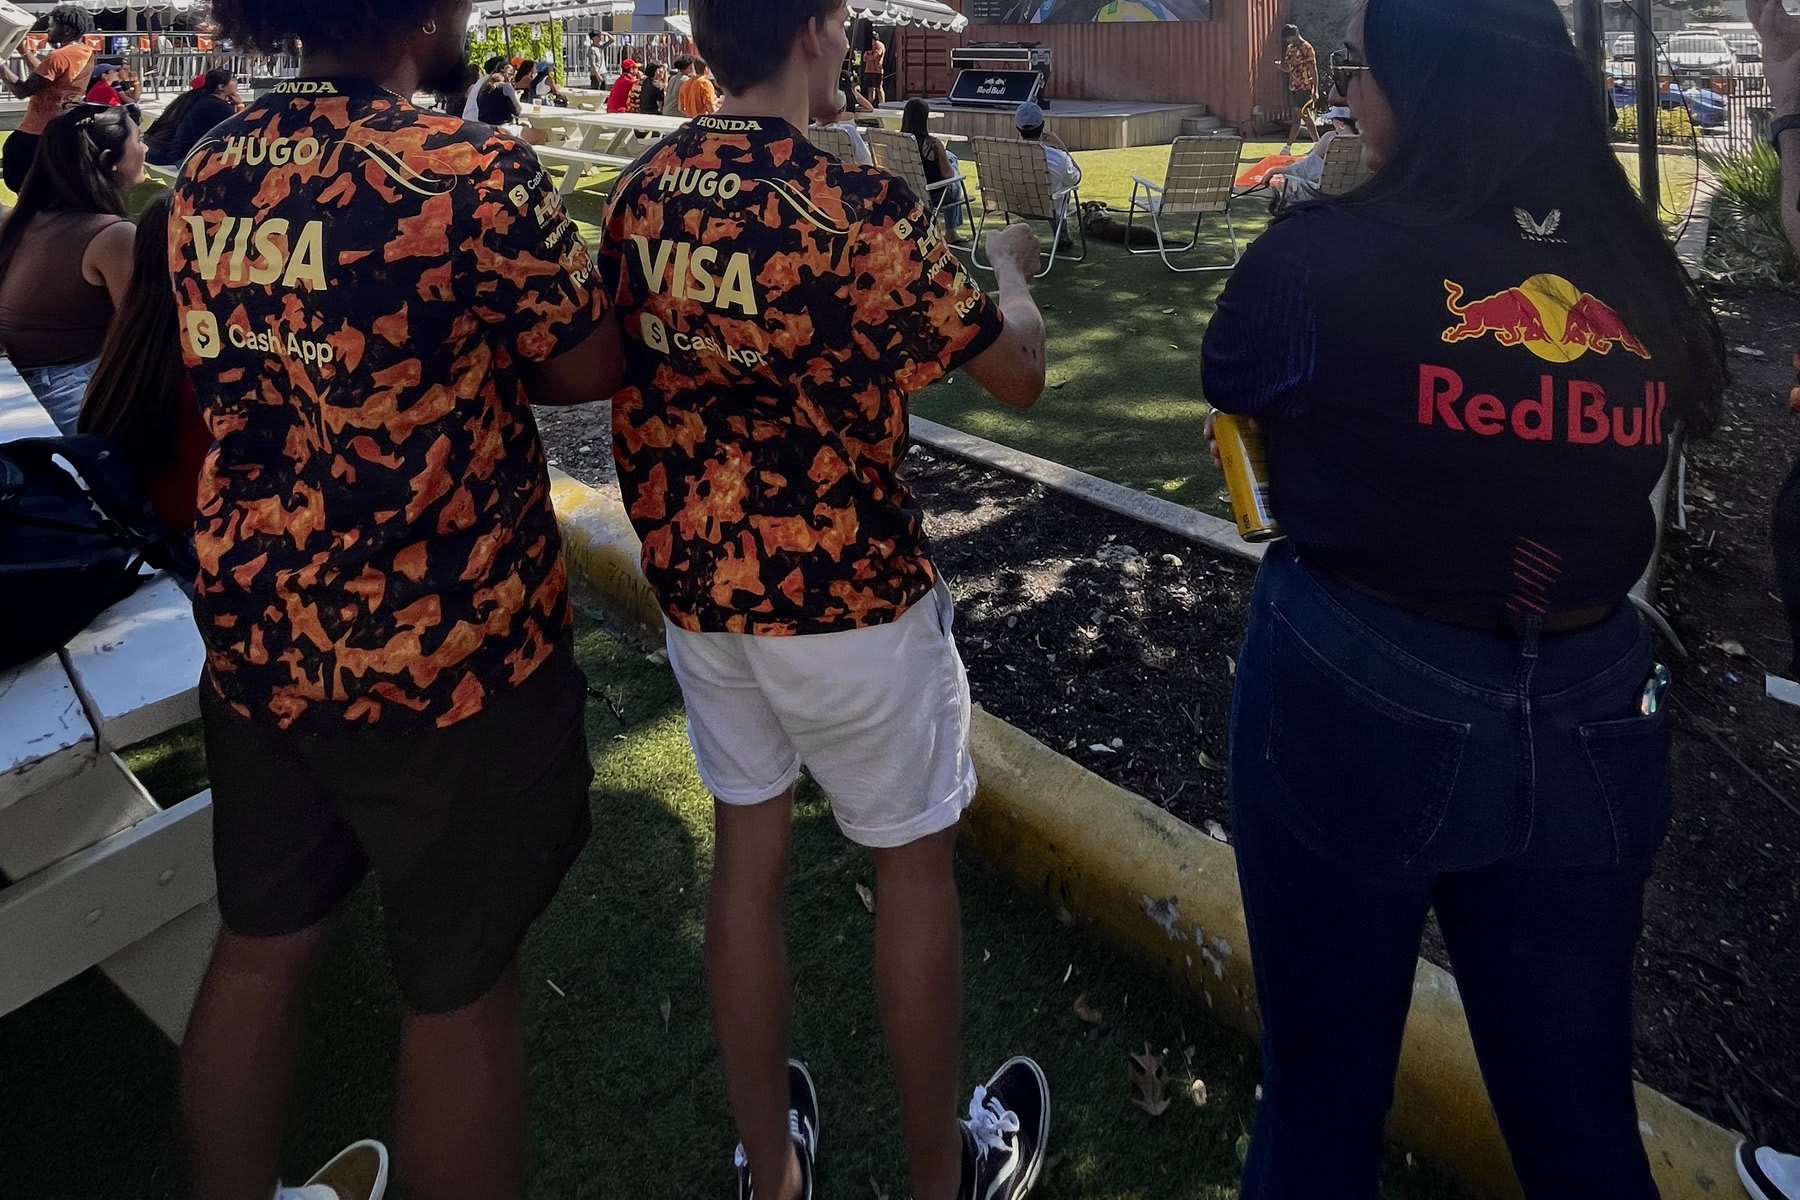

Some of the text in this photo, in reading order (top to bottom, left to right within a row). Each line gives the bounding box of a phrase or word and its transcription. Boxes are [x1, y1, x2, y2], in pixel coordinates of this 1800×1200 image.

[976, 85, 1006, 95] Red Bull
[696, 116, 762, 131] HONDA
[220, 136, 320, 166] HUGO
[658, 164, 741, 200] HUGO
[182, 215, 328, 291] VISA
[630, 233, 758, 315] VISA
[229, 323, 286, 353] Cash
[287, 332, 333, 368] App
[673, 332, 725, 358] Cash
[1417, 363, 1668, 448] Red Bull
